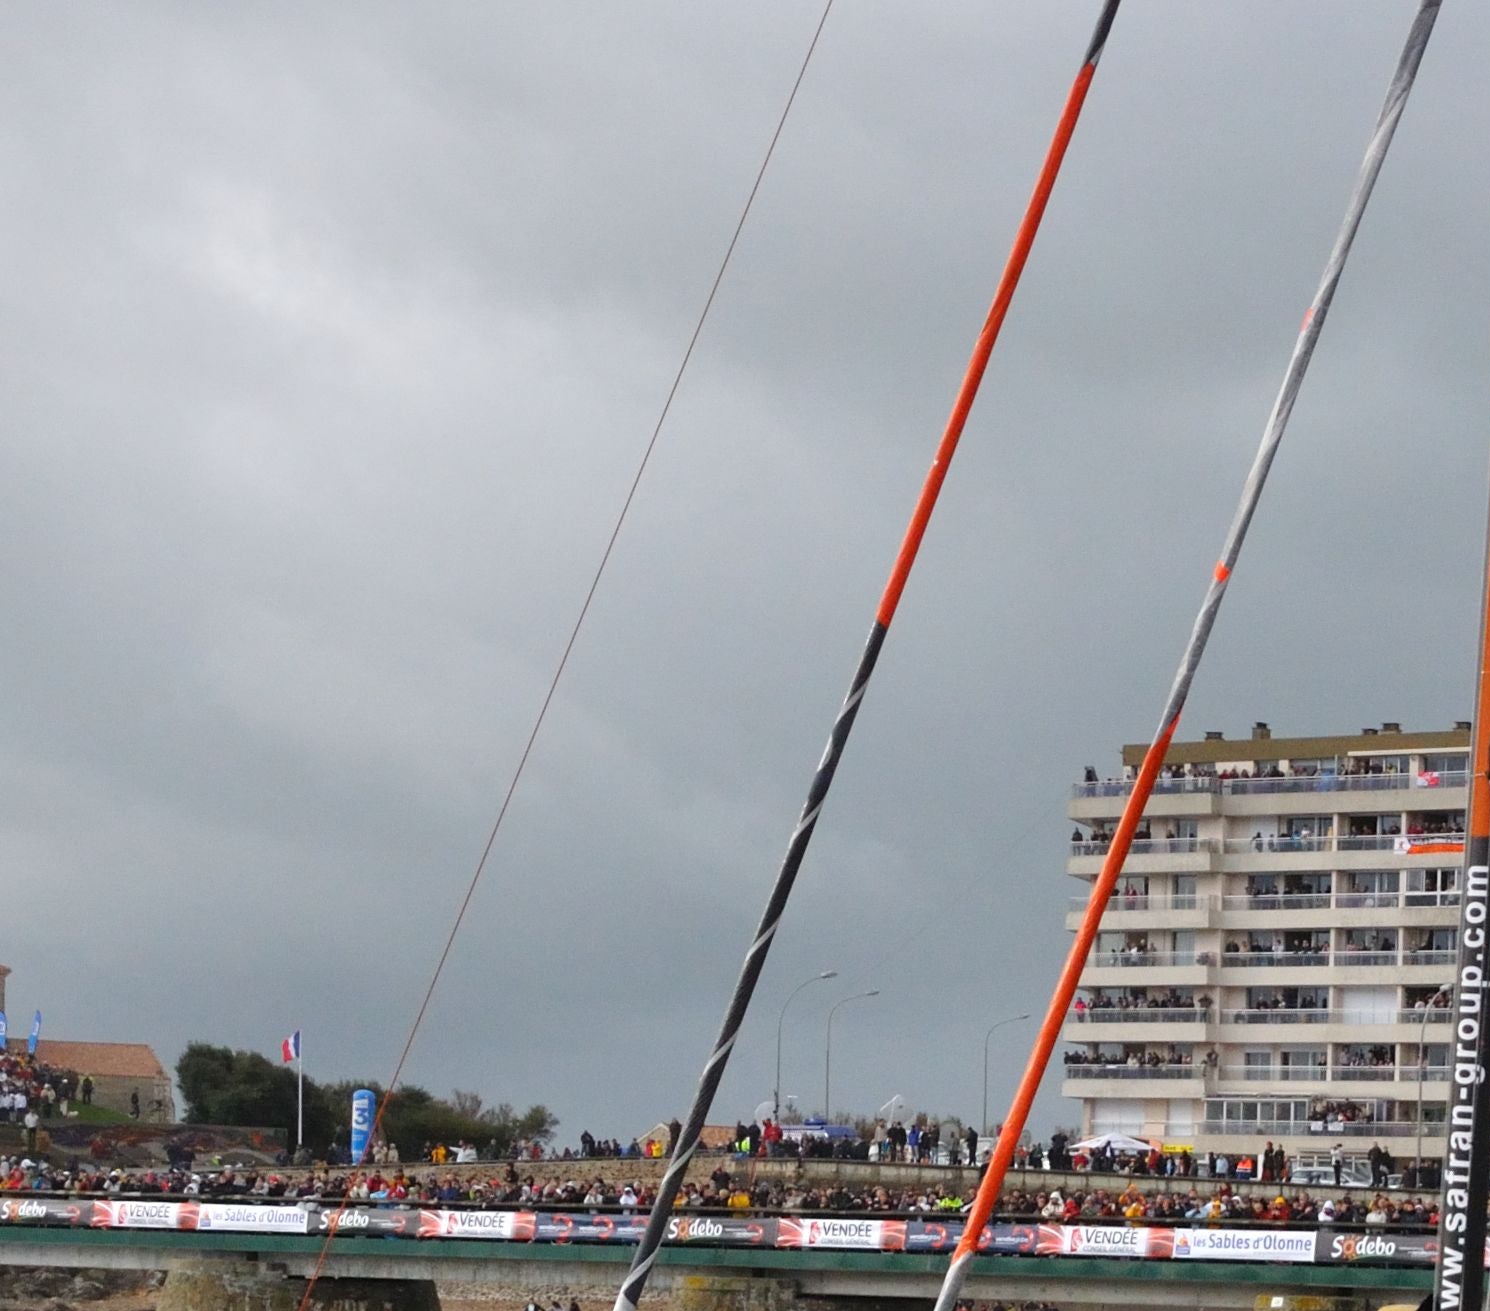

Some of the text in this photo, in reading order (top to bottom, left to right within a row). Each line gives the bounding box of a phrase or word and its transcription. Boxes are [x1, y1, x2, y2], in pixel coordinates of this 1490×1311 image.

[1, 1200, 47, 1221] Sodebo
[128, 1203, 171, 1219] VENDÉE
[212, 1208, 305, 1224] les Sables d'Olonne
[319, 1209, 369, 1230] Sodebo
[458, 1211, 505, 1228] VENDÉE
[668, 1218, 723, 1240] Sodebo
[822, 1220, 873, 1237] VENDÉE
[1084, 1228, 1138, 1246] VENDÉE
[1193, 1233, 1312, 1252] les Sables d'Olonne
[1331, 1234, 1396, 1258] Sodebo
